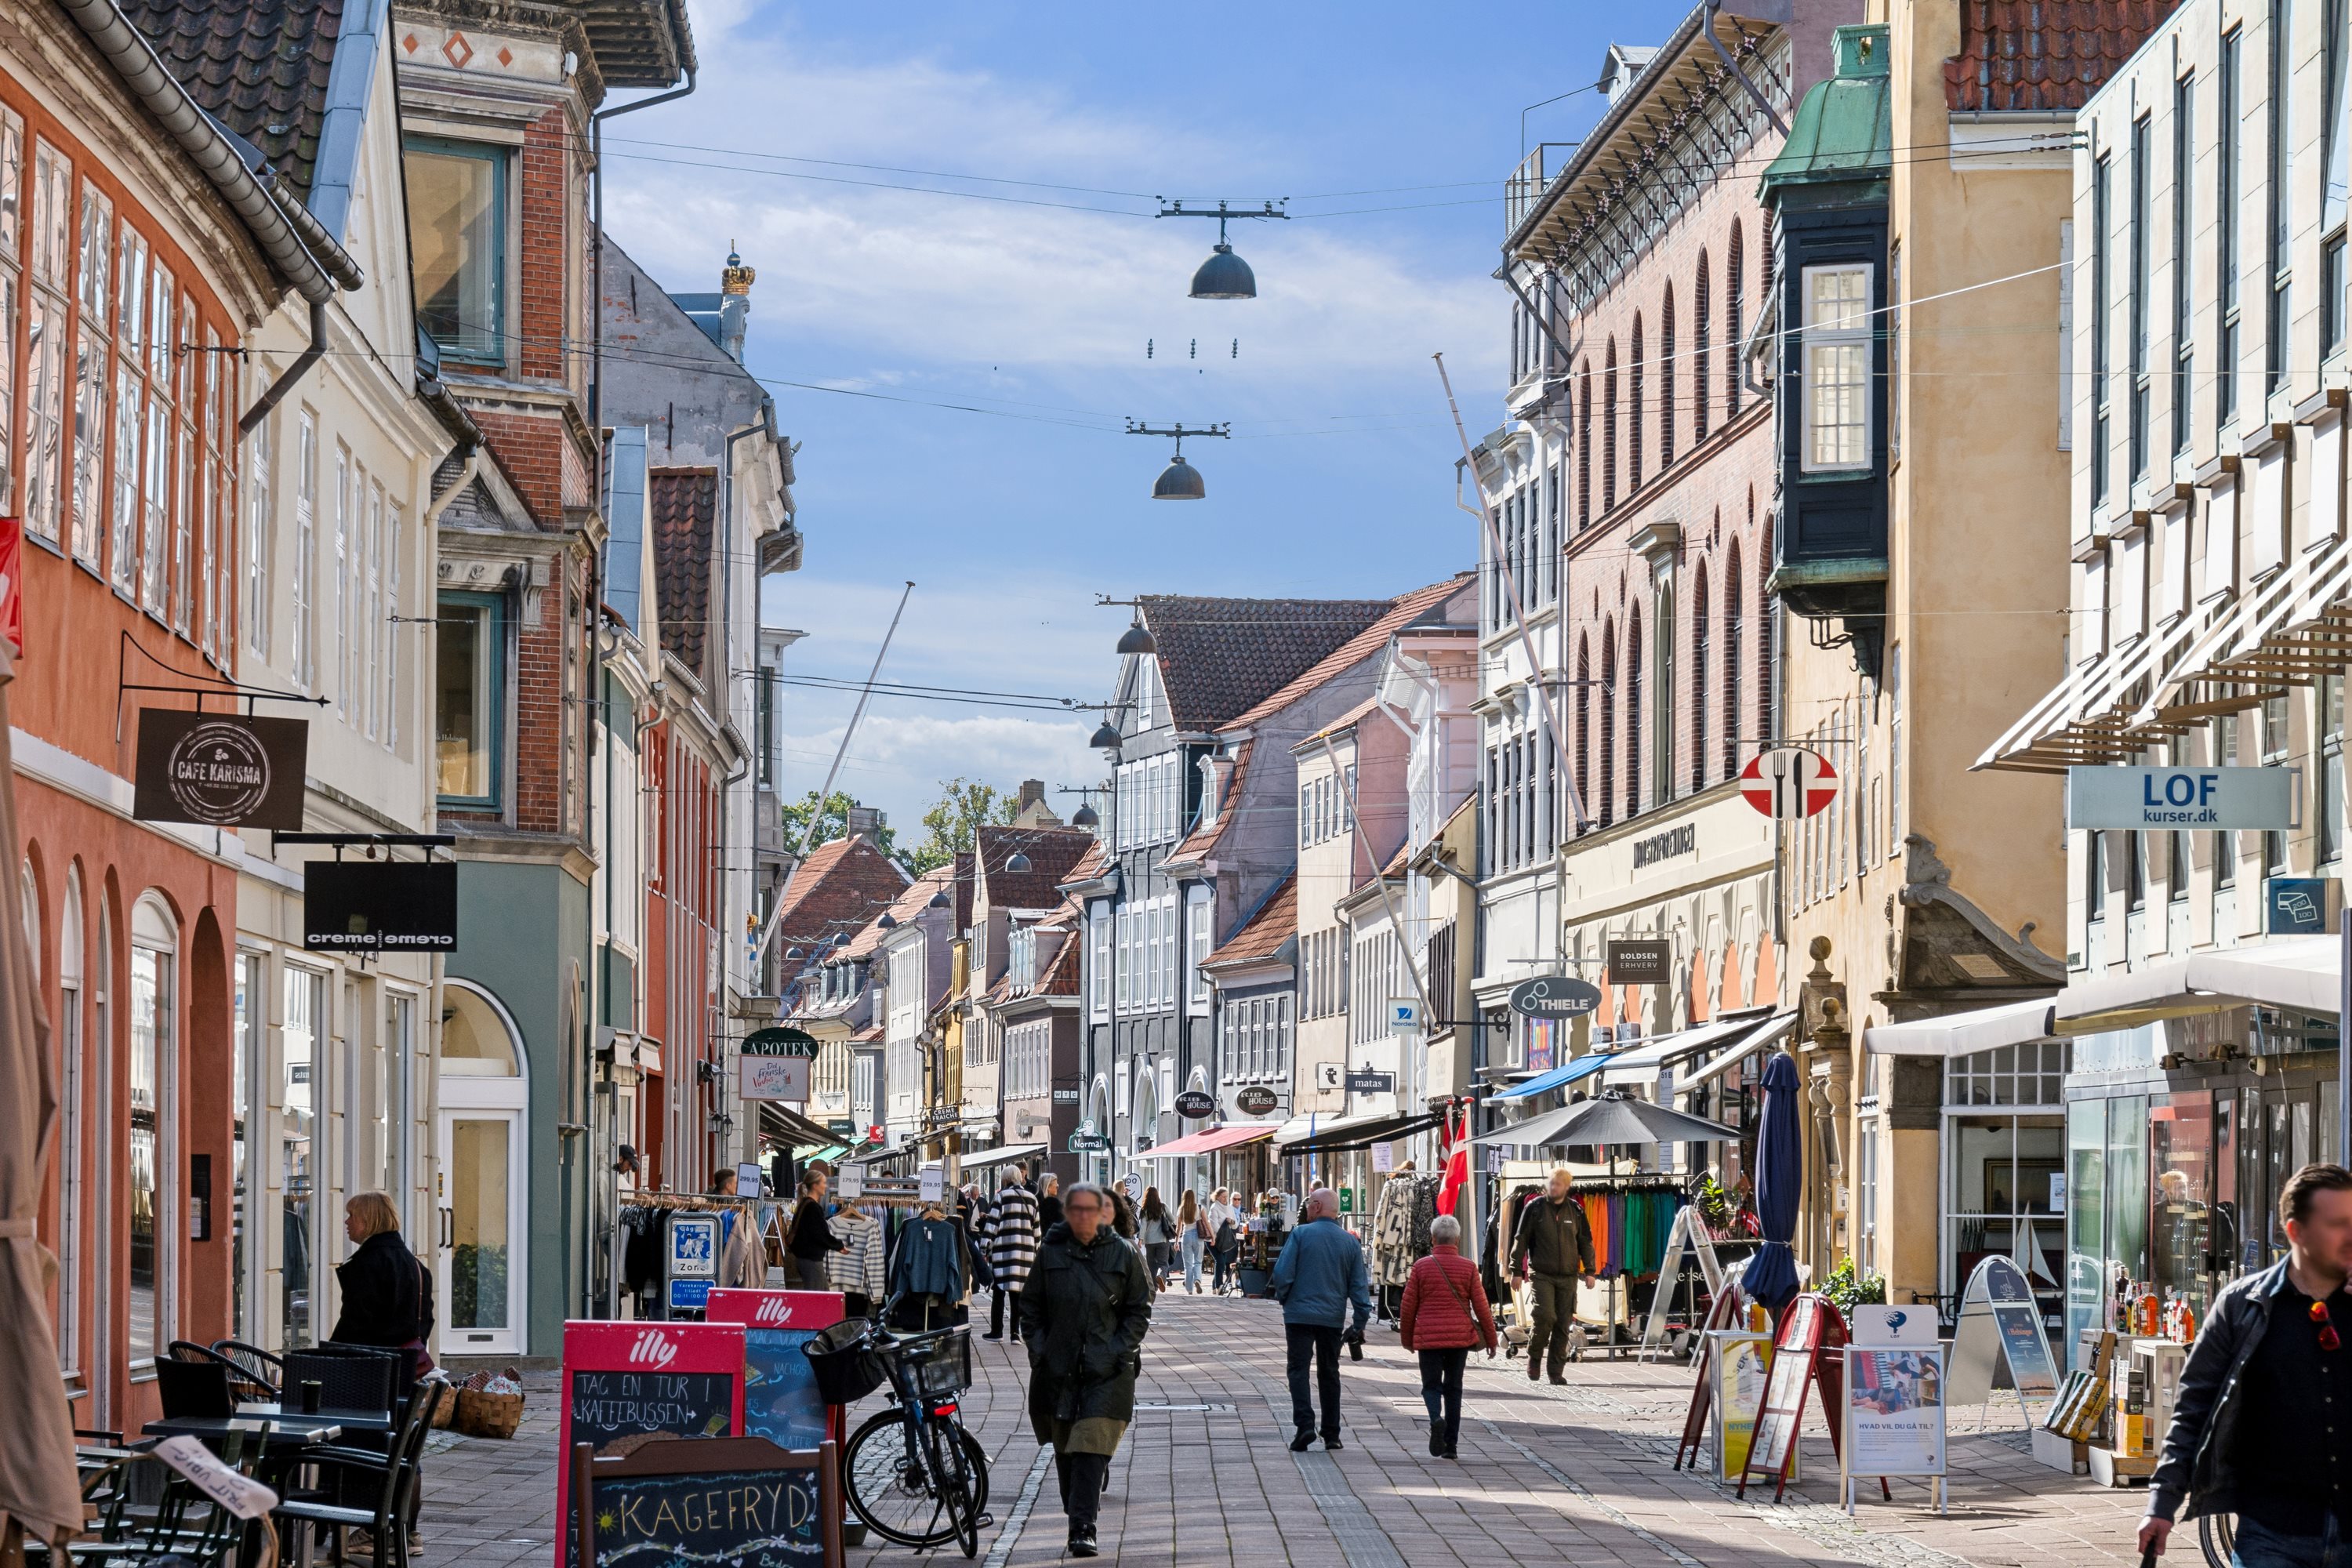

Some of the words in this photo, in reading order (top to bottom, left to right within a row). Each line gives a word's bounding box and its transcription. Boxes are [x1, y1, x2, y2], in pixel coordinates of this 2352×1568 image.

[177, 761, 206, 780] CAFE
[209, 763, 261, 785] KARISMA
[2144, 774, 2219, 807] LOF
[2143, 808, 2218, 822] kurser.dk
[2292, 899, 2307, 909] 200
[307, 934, 376, 943] creme
[1539, 999, 1589, 1011] THIELE
[750, 1042, 813, 1056] APOTEK
[758, 1066, 787, 1079] Franske
[932, 1112, 959, 1121] FRAICHE
[1074, 1138, 1102, 1148] Normal
[756, 1298, 793, 1327] illy
[746, 1330, 771, 1345] MAG
[630, 1330, 677, 1370] illy
[774, 1363, 807, 1377] NACHOS
[576, 1374, 608, 1396] TAG
[622, 1375, 641, 1397] EN
[654, 1375, 688, 1401] TUR
[580, 1399, 689, 1425] KAFFEBUSSEN
[620, 1483, 808, 1537] KAGEFRYD
